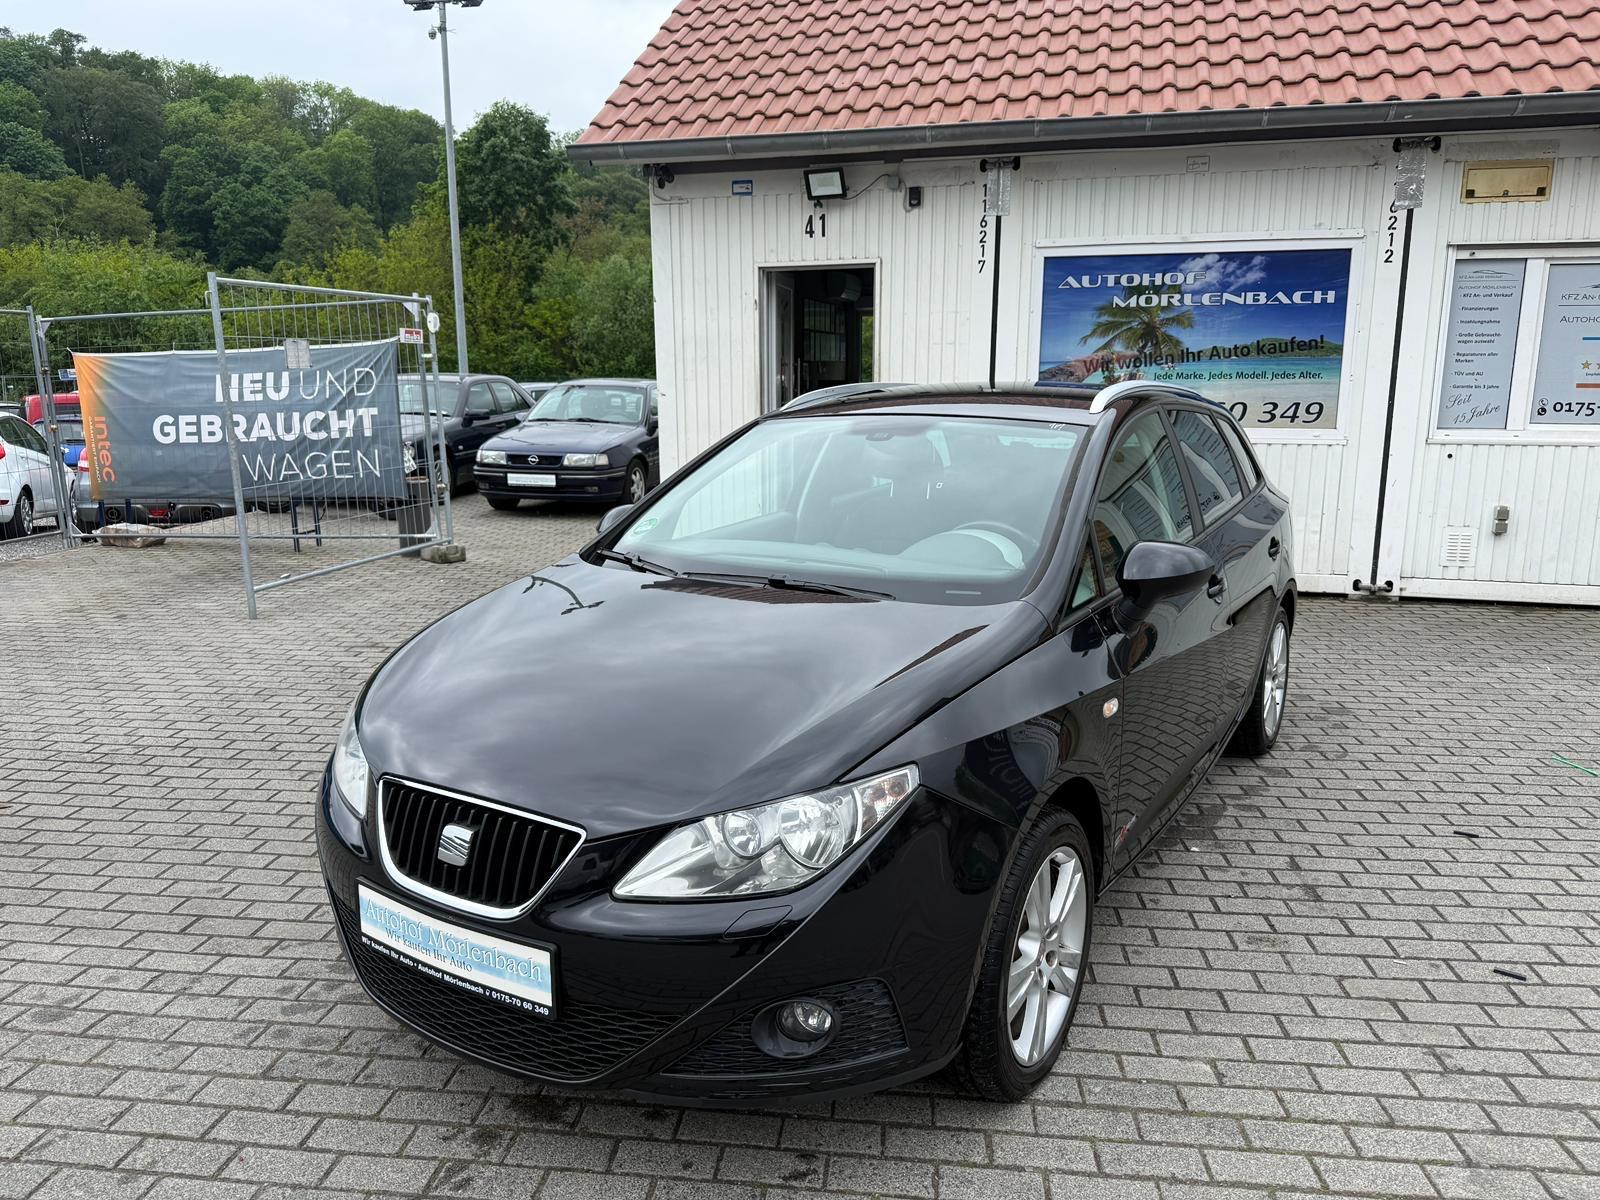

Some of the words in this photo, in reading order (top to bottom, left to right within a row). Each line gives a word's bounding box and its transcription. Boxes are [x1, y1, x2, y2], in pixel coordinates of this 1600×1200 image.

[805, 213, 826, 239] 41
[978, 184, 988, 274] 116217
[1384, 165, 1399, 263] 6212
[1058, 271, 1207, 289] AUTOHOF
[1561, 293, 1580, 301] KFZ
[1113, 290, 1336, 308] MÖRLENBACH
[1083, 358, 1112, 374] Wir
[1118, 351, 1174, 370] wollen
[1180, 347, 1203, 364] Ihr
[1209, 343, 1250, 361] Auto
[1256, 334, 1325, 356] kaufen!
[215, 371, 290, 403] NEU
[299, 367, 377, 400] UND
[1153, 372, 1174, 382] Jede
[1175, 371, 1206, 381] Marke.
[1207, 371, 1233, 381] Jedes
[1235, 371, 1269, 380] Modell.
[1270, 371, 1297, 381] Jedes
[1298, 370, 1323, 380] Alter.
[1256, 401, 1325, 424] 349
[1445, 393, 1472, 409] Seit
[1453, 412, 1466, 424] 15
[1466, 402, 1501, 423] Jahre
[152, 407, 379, 444] GEBRAUCHT
[94, 416, 116, 482] intec
[242, 448, 381, 481] WAGEN
[366, 897, 423, 940] Autohof
[428, 927, 542, 982] Mörlenbach
[385, 926, 401, 943] Wir
[402, 934, 431, 957] kaufen
[433, 947, 448, 963] Ihr
[450, 955, 473, 972] Auto
[361, 935, 371, 945] Wir
[371, 940, 390, 955] kaufen
[390, 950, 399, 960] Ihr
[399, 955, 413, 967] Auto
[418, 963, 442, 979] Autohof
[443, 973, 484, 994] Mörlenbach
[491, 990, 521, 1007] 0175-70
[522, 1001, 533, 1011] 60
[534, 1004, 549, 1016] 349
